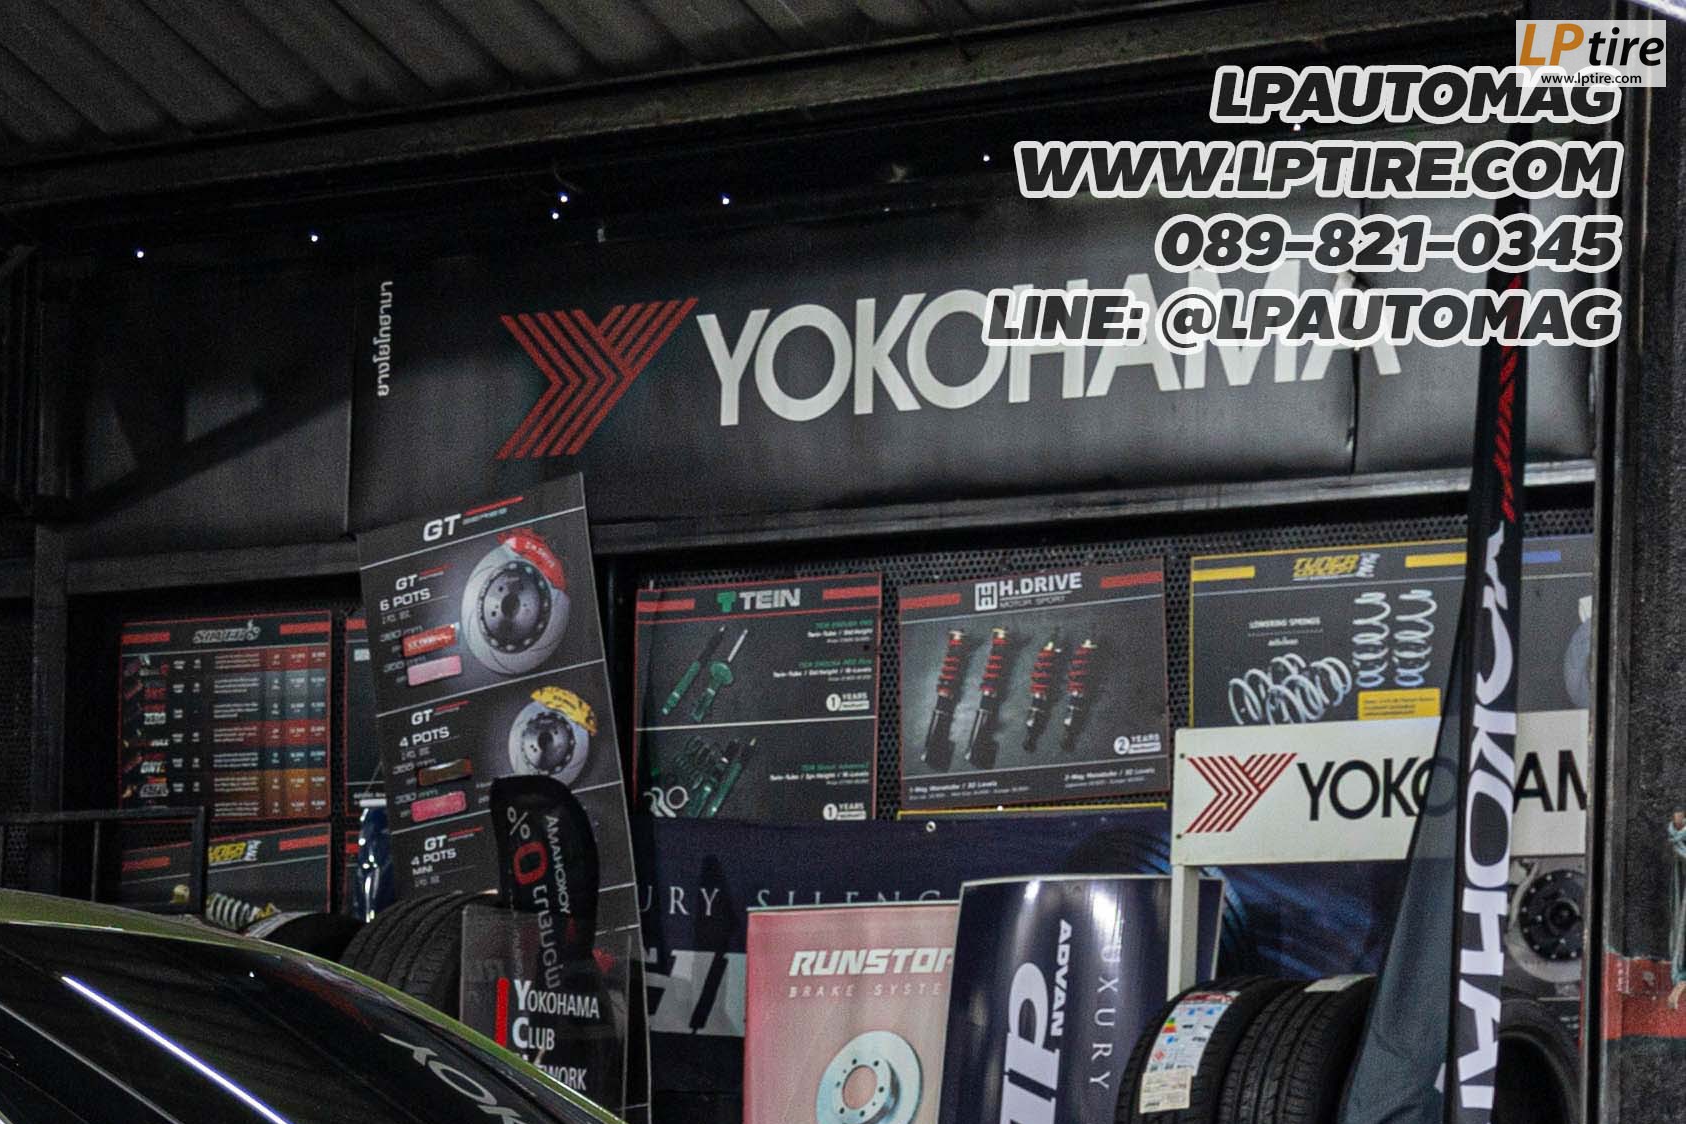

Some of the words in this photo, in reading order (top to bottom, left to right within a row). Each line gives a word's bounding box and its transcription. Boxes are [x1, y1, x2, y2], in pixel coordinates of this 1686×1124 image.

[373, 281, 393, 396] ยางโยโกฮามา
[423, 513, 462, 542] GT
[395, 574, 418, 591] GT
[999, 572, 1083, 597] H.DRIVE
[380, 599, 390, 612] 6
[393, 588, 431, 608] POTS
[739, 588, 801, 611] TEIN
[411, 709, 433, 726] GT
[399, 736, 409, 749] 4
[412, 726, 450, 746] POTS
[424, 835, 448, 851] GT
[411, 855, 421, 867] 4
[423, 849, 457, 865] POTS
[1050, 919, 1073, 1037] ADVAN
[514, 979, 600, 1019] YOKOHAMA
[789, 984, 854, 999] BRAKE
[512, 1017, 555, 1050] CLUB
